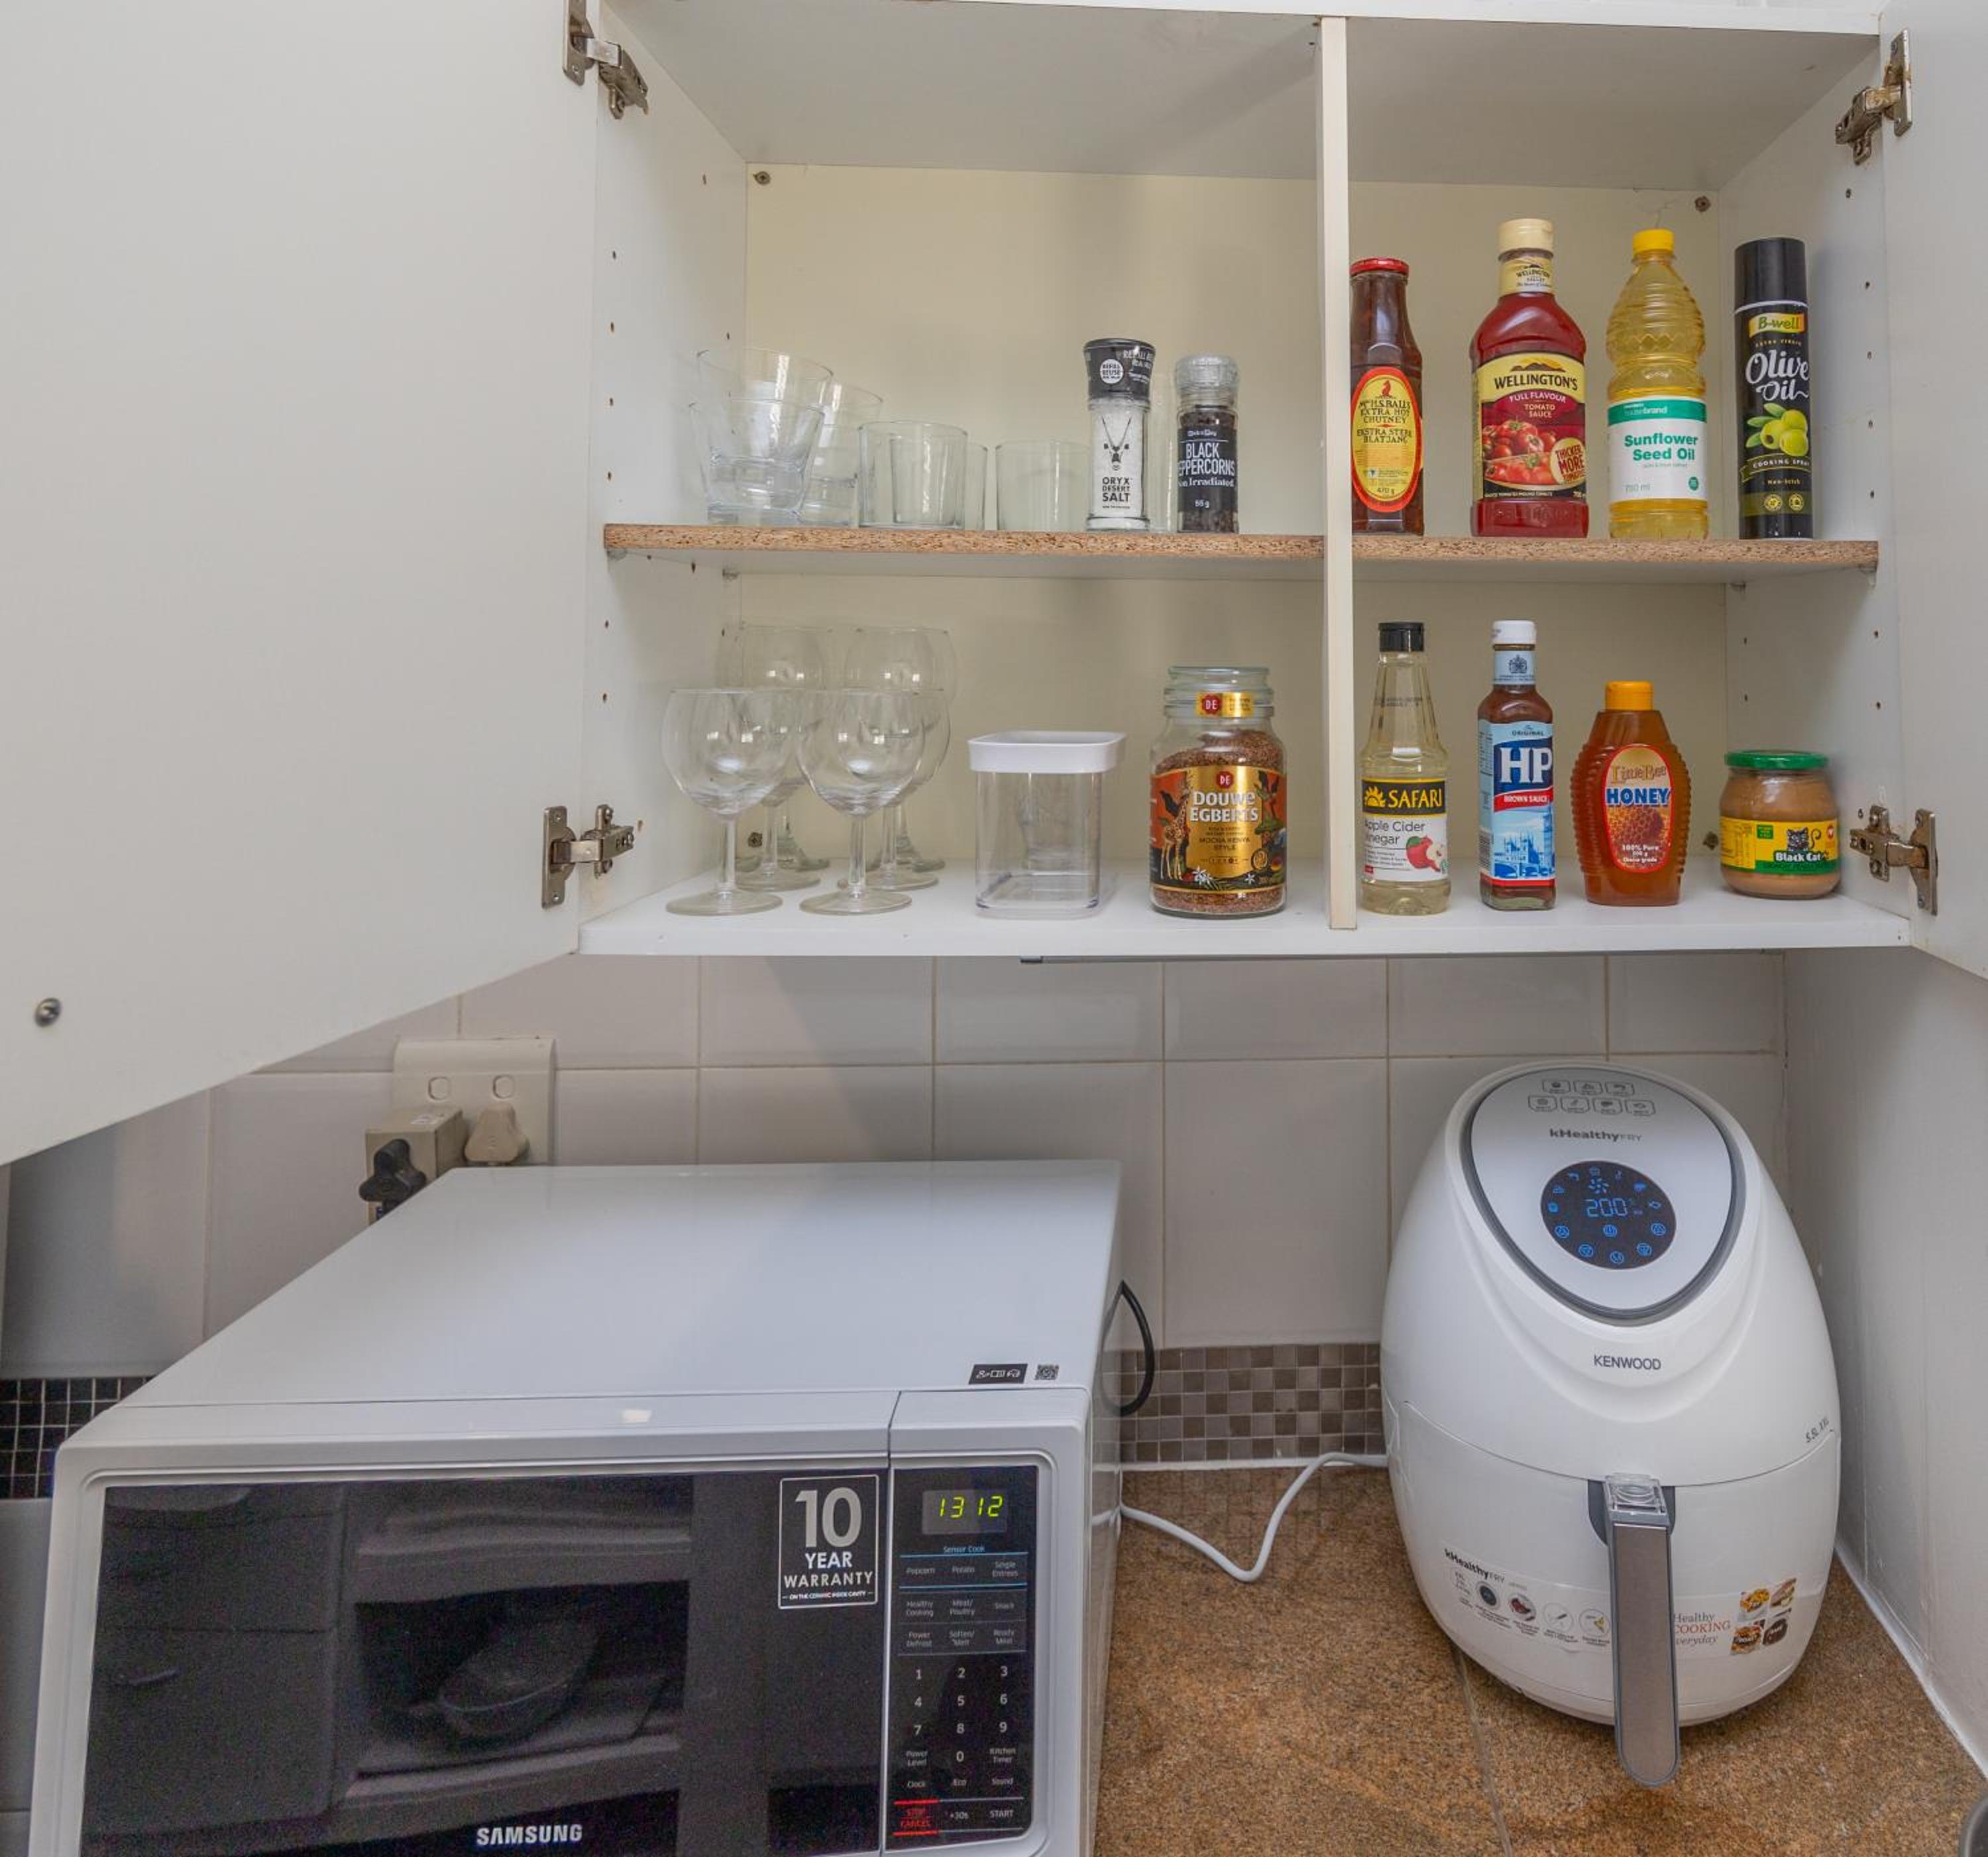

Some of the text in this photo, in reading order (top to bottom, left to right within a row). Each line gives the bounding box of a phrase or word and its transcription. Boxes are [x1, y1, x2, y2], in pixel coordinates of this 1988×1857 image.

[1759, 316, 1799, 329] B-well
[1745, 349, 1809, 384] Olive
[1494, 374, 1578, 391] WELLINGTON'S
[1756, 380, 1808, 400] Oil
[1510, 392, 1566, 402] FULL FLAVOUR
[1624, 432, 1698, 447] Sunflower
[1186, 441, 1220, 459] BLACK
[1633, 447, 1695, 461] Seed Oil
[1753, 458, 1790, 468] COOKING
[1102, 477, 1130, 485] ORYX
[1102, 492, 1131, 502] SALT
[1500, 747, 1553, 783] HP
[1388, 788, 1443, 808] SAFARI
[1606, 787, 1672, 807] HONEY
[1189, 807, 1258, 822] EGBERTS
[1392, 820, 1425, 832] Cider
[1775, 852, 1821, 862] Black Cat
[1584, 1198, 1628, 1217] 200
[1594, 1354, 1661, 1370] KENWOOD
[795, 1487, 862, 1548] 10
[804, 1551, 853, 1569] YEAR
[784, 1571, 873, 1589] WARRANTY
[916, 1669, 922, 1680] 1
[958, 1667, 966, 1679] 2
[1000, 1665, 1008, 1677] 3
[914, 1696, 922, 1707] 4
[958, 1695, 965, 1707] 5
[1000, 1693, 1008, 1705] 6
[913, 1724, 922, 1736] 7
[956, 1723, 965, 1734] 8
[999, 1721, 1007, 1733] 9
[956, 1751, 964, 1762] 0
[989, 1809, 1014, 1818] START
[476, 1824, 583, 1846] SAMSUNG
